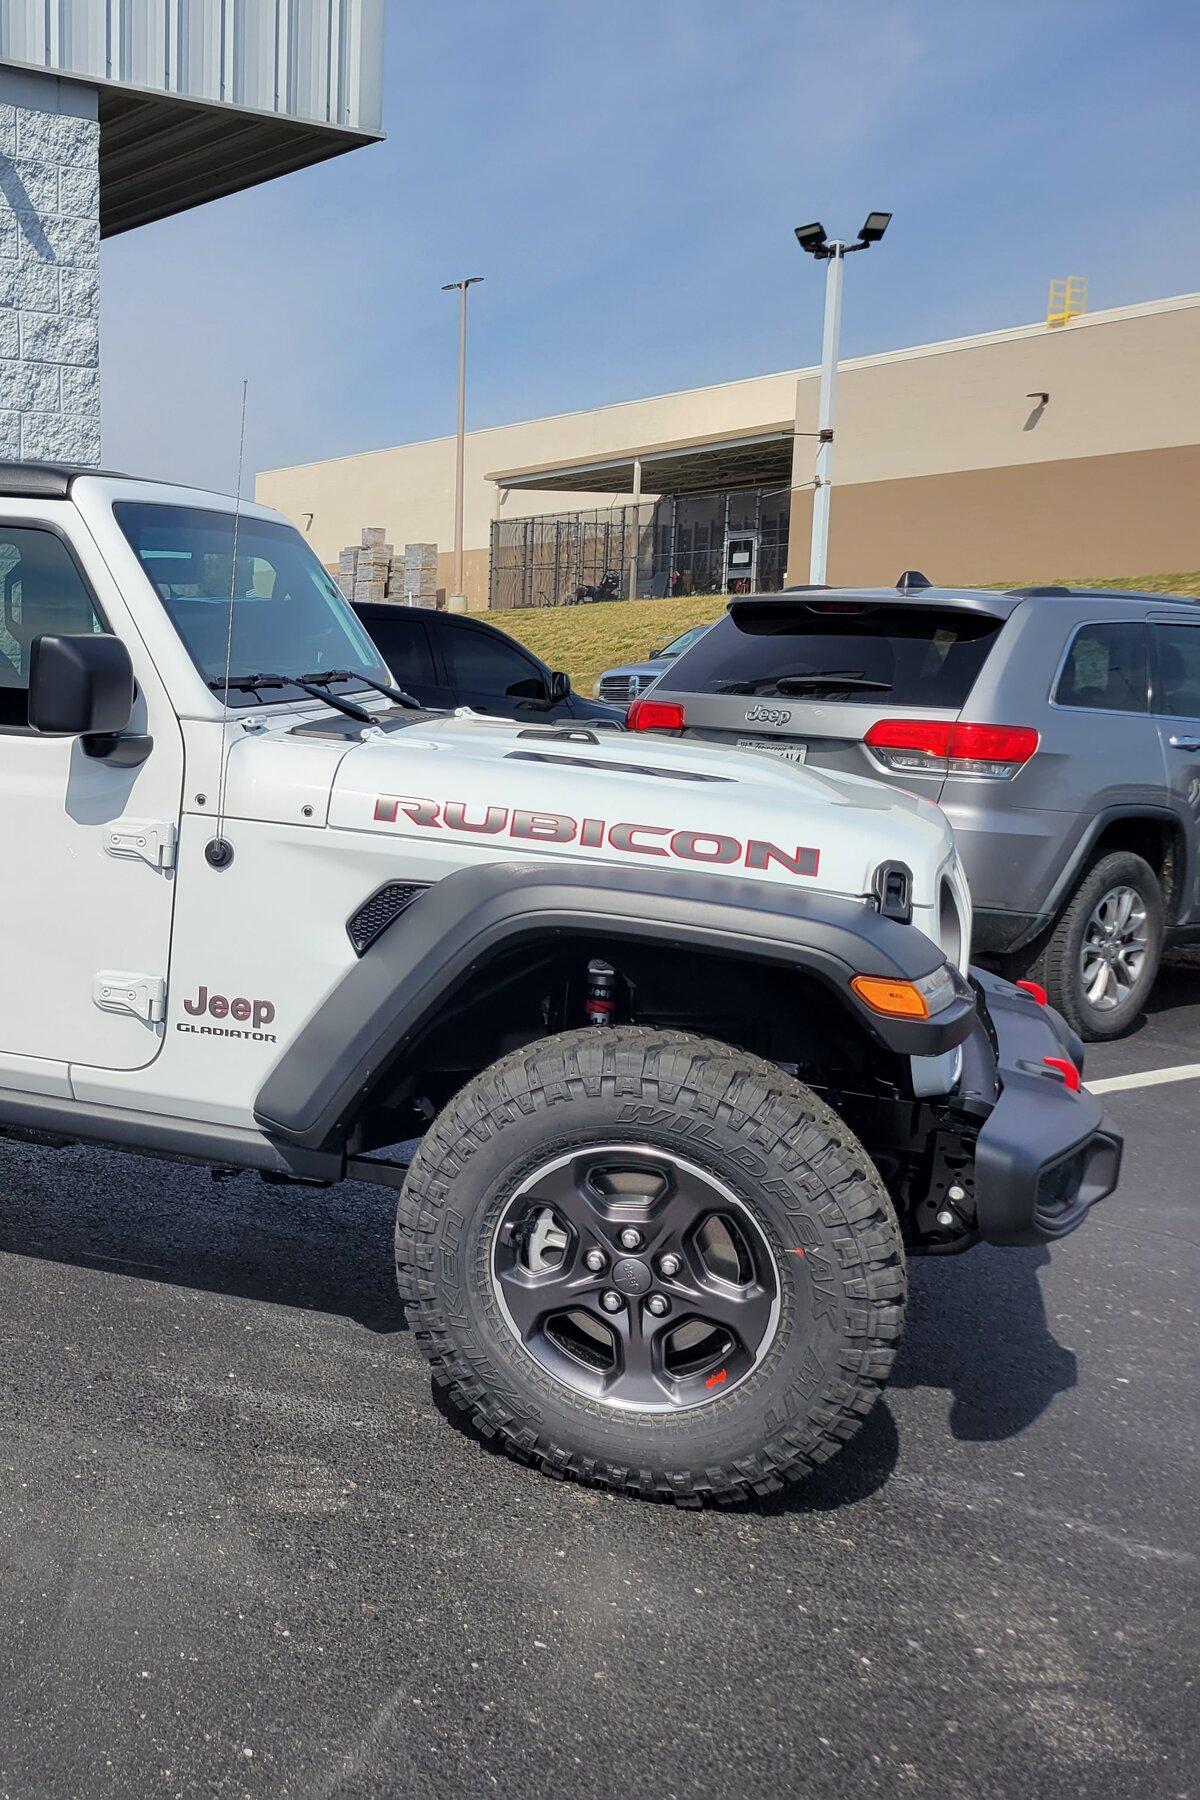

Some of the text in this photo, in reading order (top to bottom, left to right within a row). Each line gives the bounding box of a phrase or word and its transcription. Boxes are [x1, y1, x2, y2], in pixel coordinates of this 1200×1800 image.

[745, 705, 791, 726] Jeep
[373, 793, 821, 877] RUBICON
[183, 985, 276, 1029] Jeep
[176, 1022, 277, 1043] GLADIATOR
[615, 1103, 838, 1334] WILDPEAK
